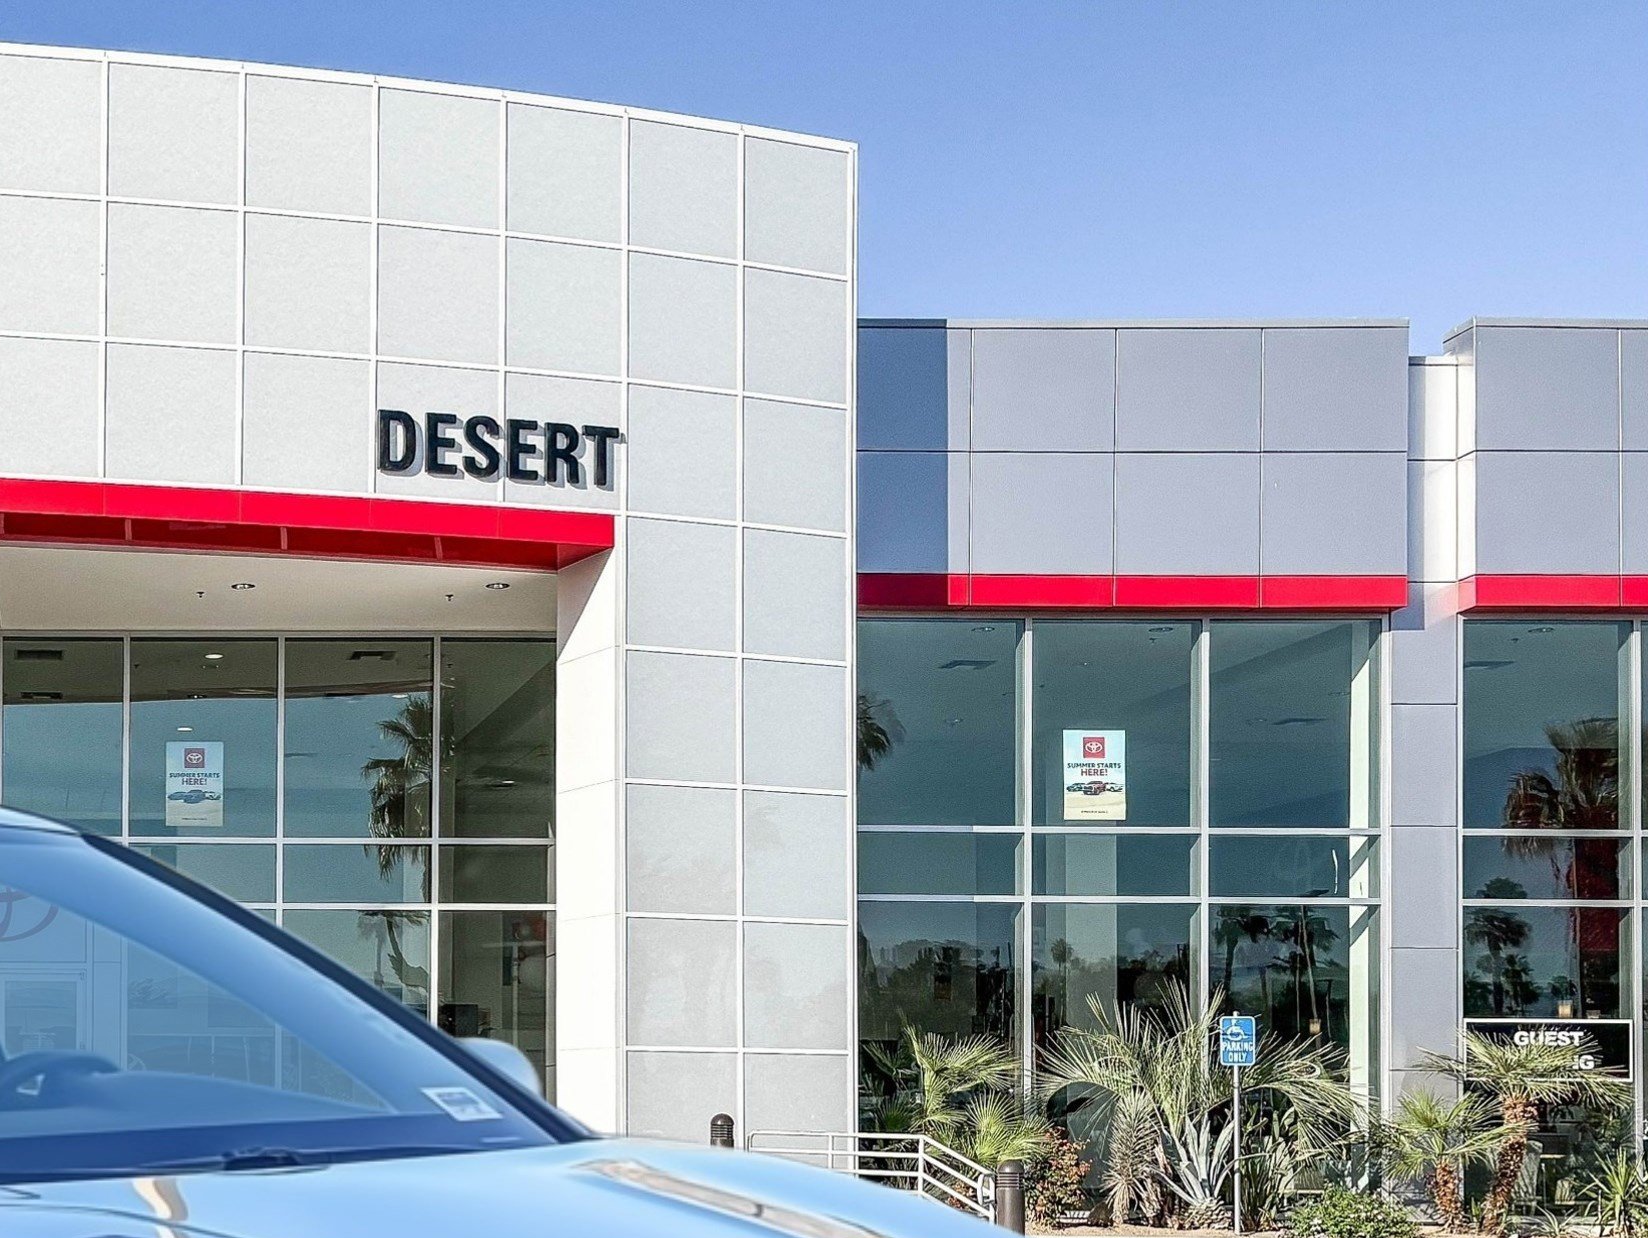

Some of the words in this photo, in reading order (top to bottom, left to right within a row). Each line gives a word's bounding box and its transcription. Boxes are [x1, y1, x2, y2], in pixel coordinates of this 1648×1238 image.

[377, 409, 620, 487] DESERT
[1080, 768, 1108, 776] HERE!
[181, 777, 208, 786] HERE!
[1513, 1030, 1585, 1047] GUEST
[1222, 1041, 1253, 1052] PARKING
[1228, 1052, 1248, 1062] ONLY
